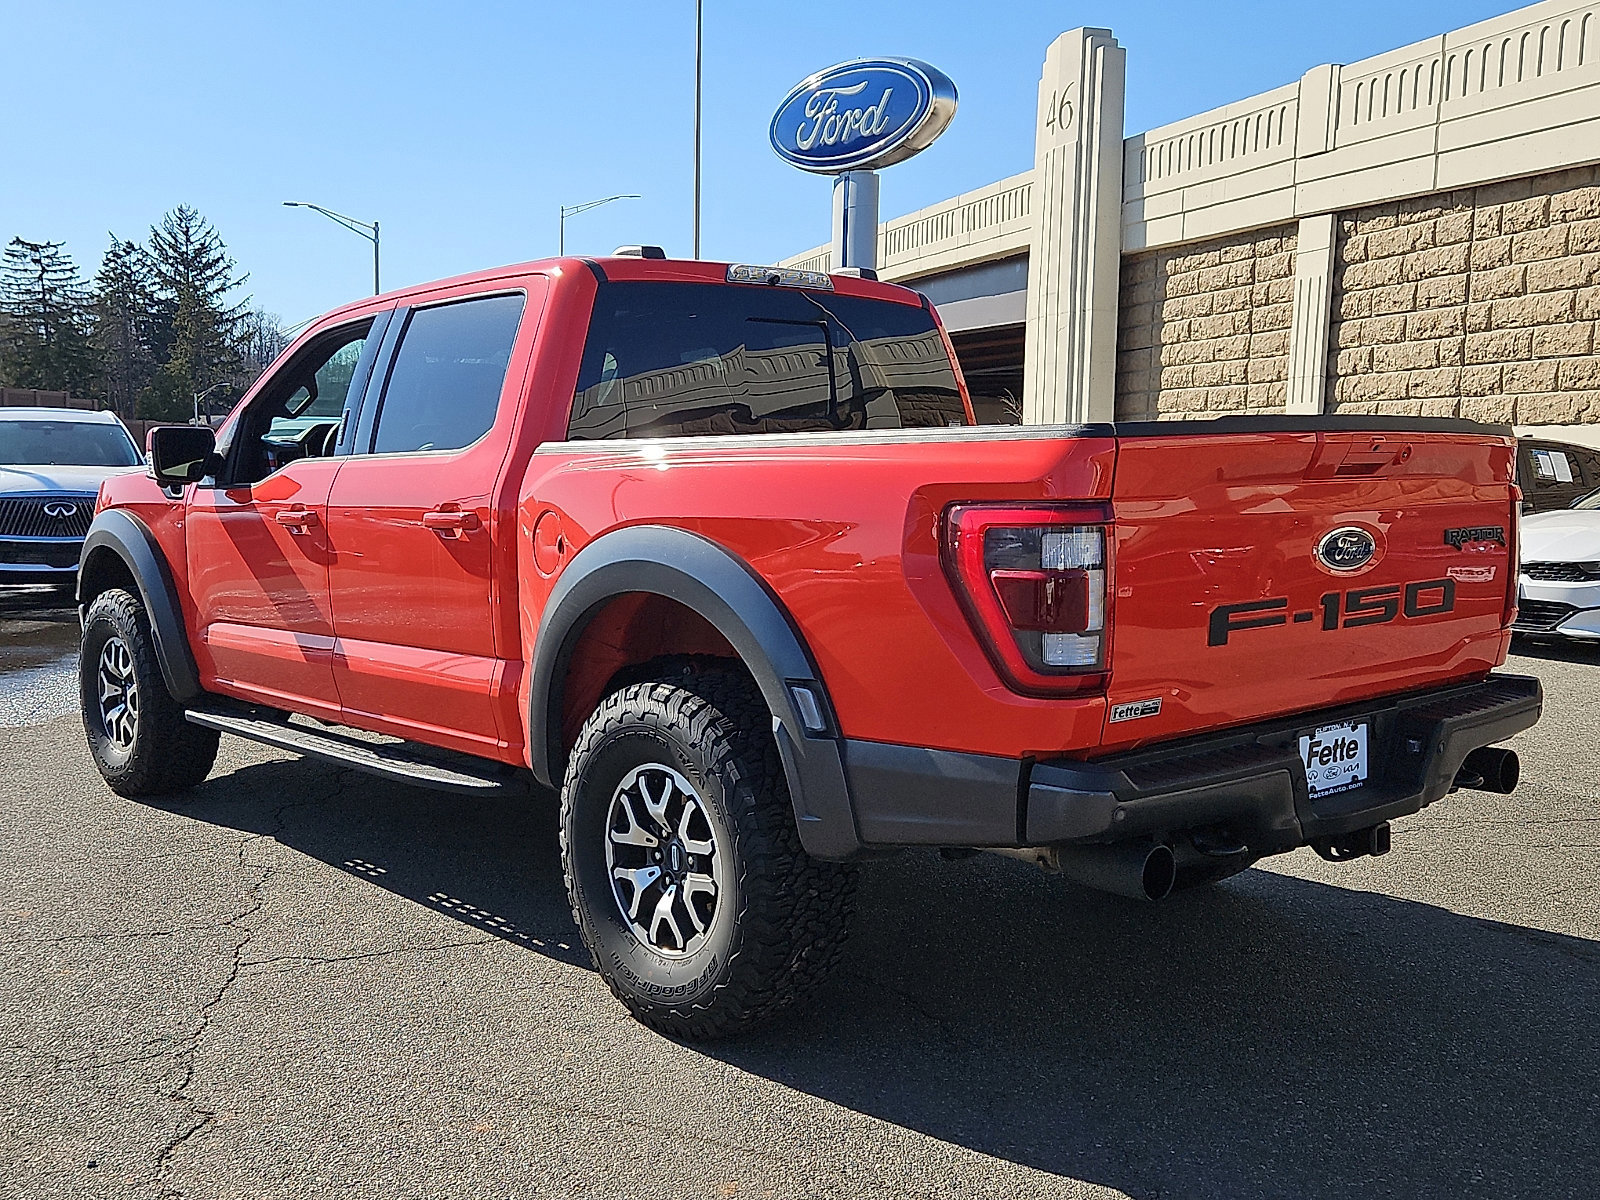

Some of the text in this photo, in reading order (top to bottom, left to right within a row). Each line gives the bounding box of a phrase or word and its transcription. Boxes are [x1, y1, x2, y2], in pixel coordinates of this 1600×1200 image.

[796, 80, 893, 151] Ford
[1045, 81, 1076, 136] 46
[1334, 535, 1368, 561] Ford
[1444, 526, 1506, 550] RAPTOR
[1208, 578, 1456, 648] F-150
[1112, 705, 1140, 720] Fette
[1306, 736, 1359, 770] Fette
[1309, 781, 1363, 800] FetteAuto.com
[610, 950, 719, 999] BFGoodrich
